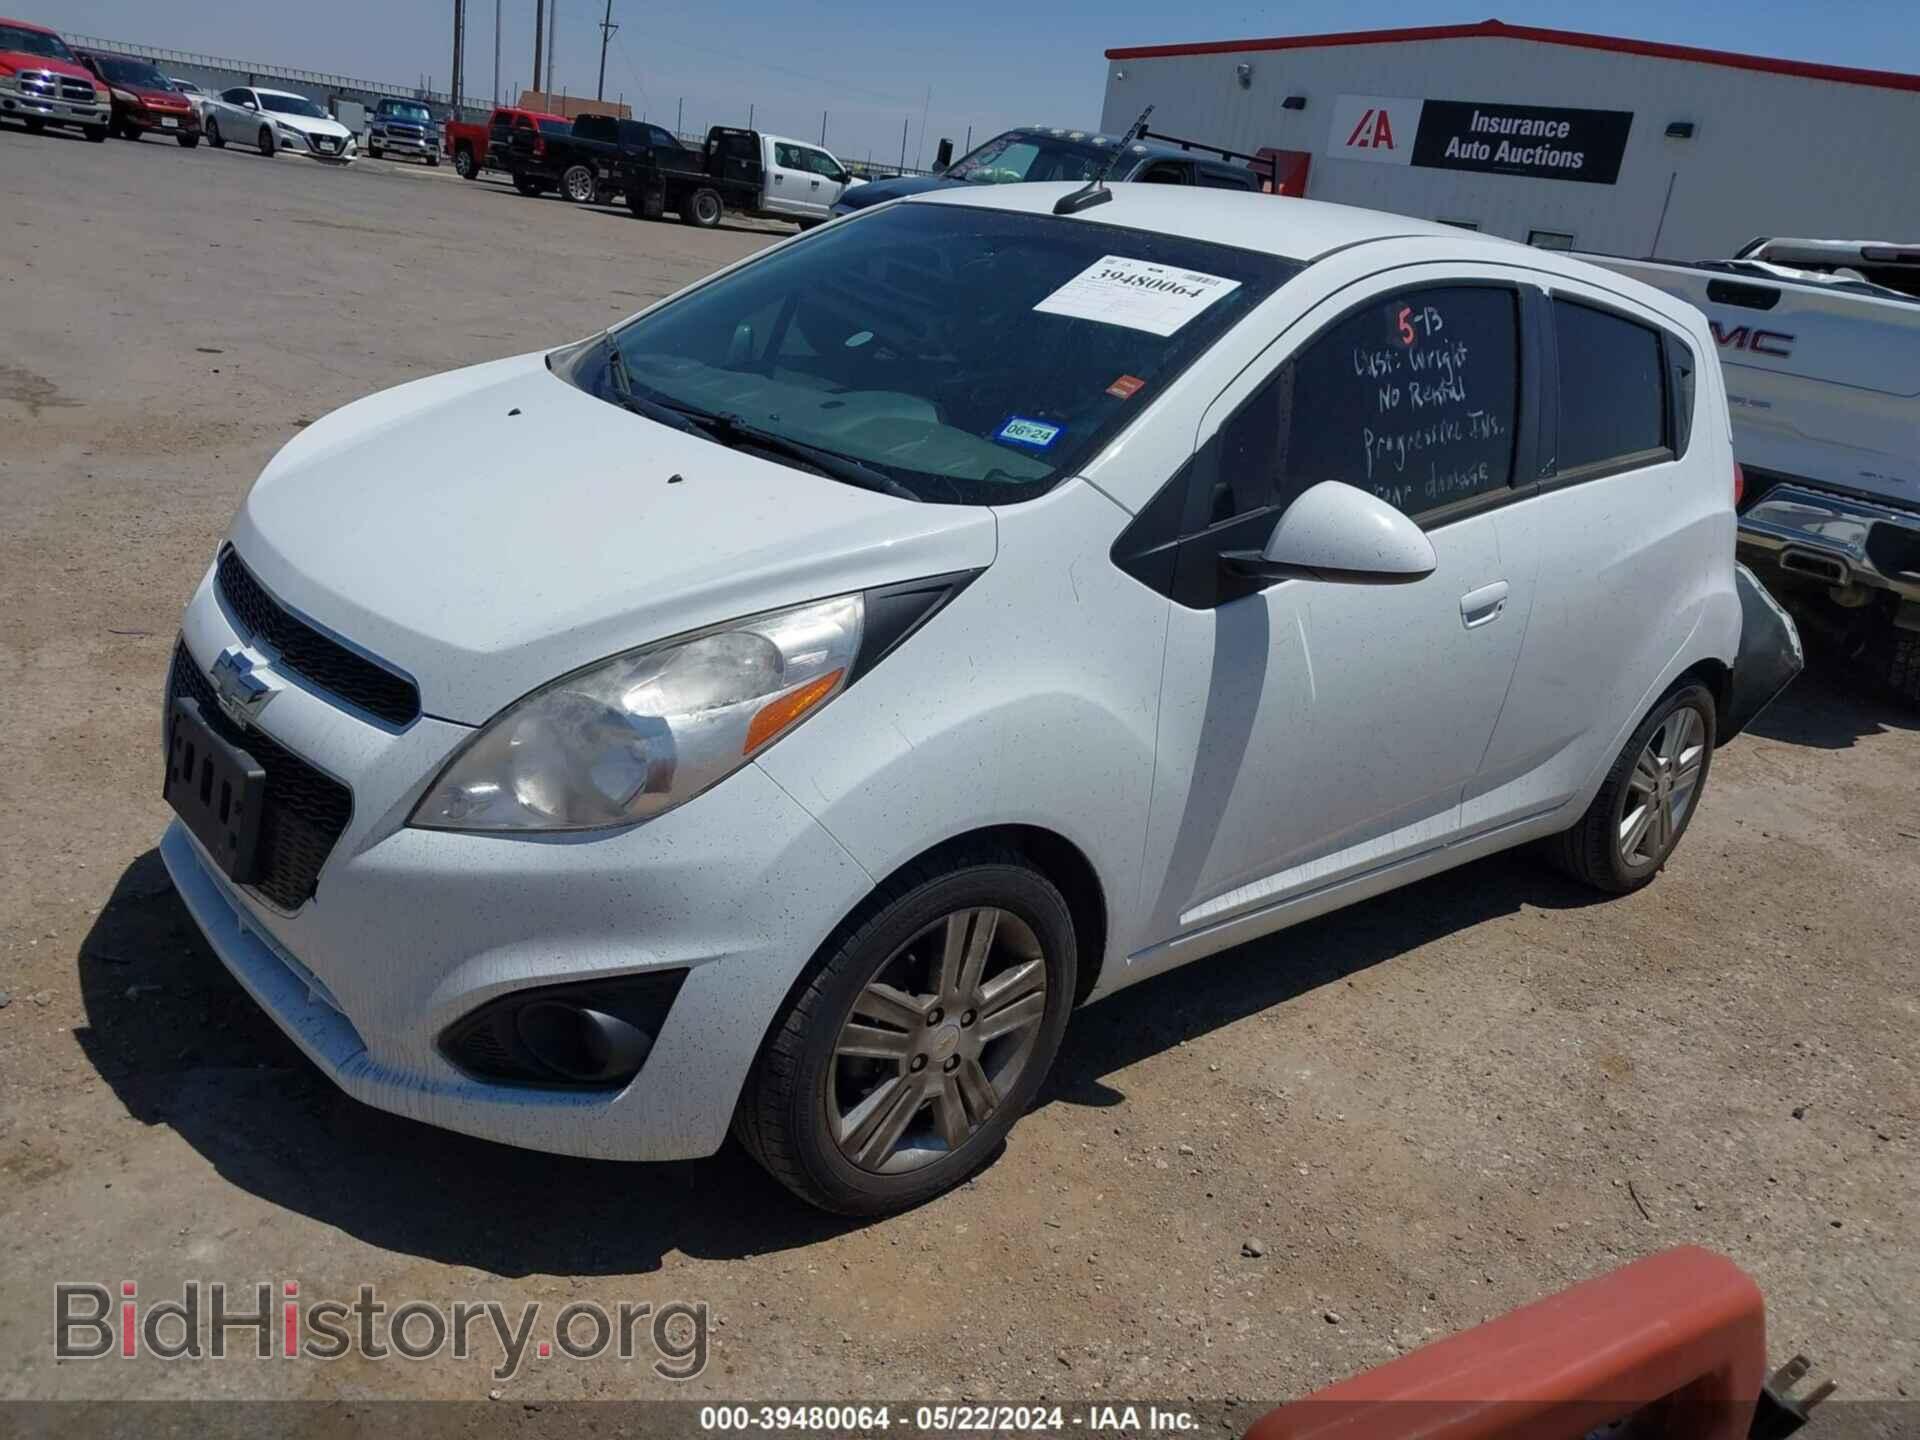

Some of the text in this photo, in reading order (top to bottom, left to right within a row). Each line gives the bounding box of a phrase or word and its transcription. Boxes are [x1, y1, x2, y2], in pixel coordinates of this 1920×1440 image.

[1471, 110, 1570, 138] Insurance
[1445, 136, 1585, 169] Auto Auctions
[1091, 269, 1205, 298] 39480064
[1709, 320, 1794, 358] MC
